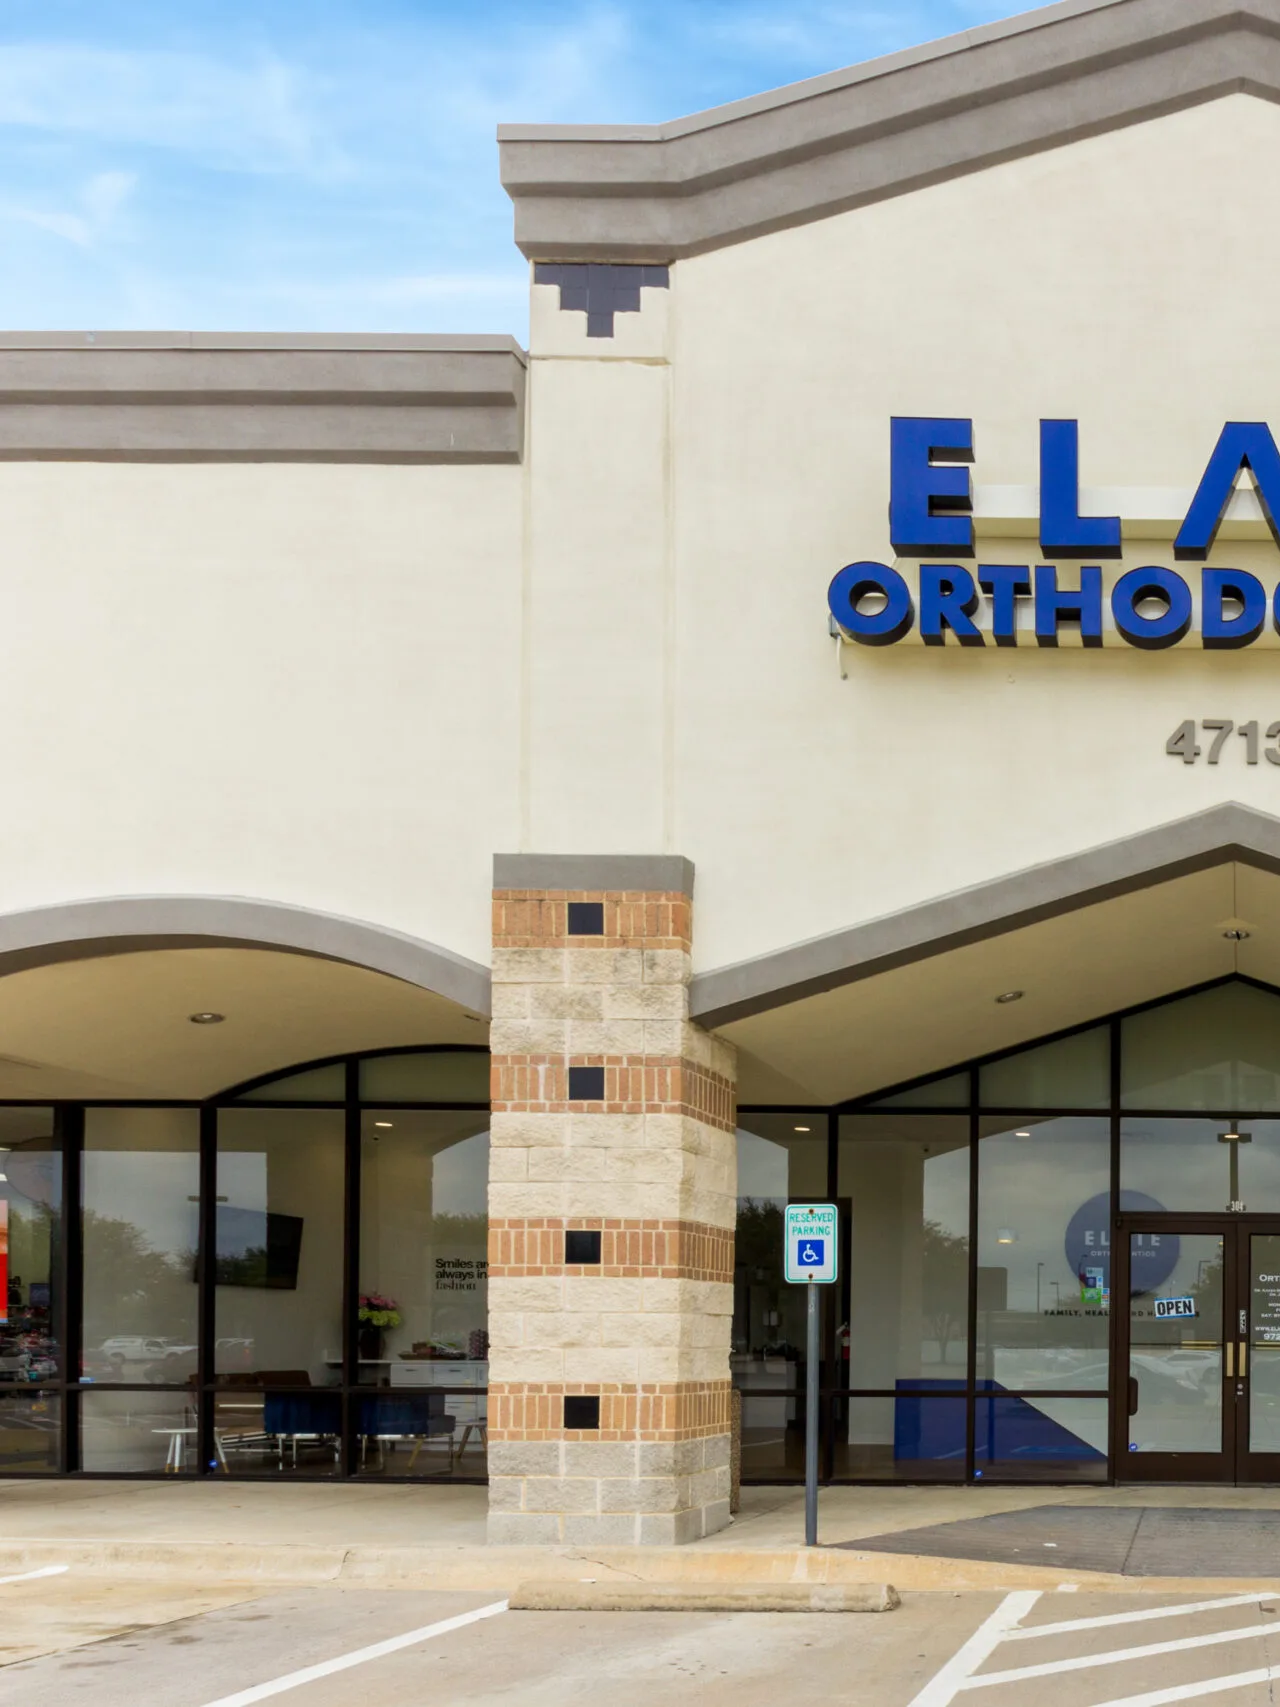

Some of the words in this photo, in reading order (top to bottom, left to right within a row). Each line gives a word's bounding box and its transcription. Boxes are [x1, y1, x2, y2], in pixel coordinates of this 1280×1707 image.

[789, 1212, 834, 1223] RESERVED
[792, 1226, 831, 1236] PARKING
[435, 1258, 474, 1269] Smiles
[435, 1269, 475, 1281] always
[477, 1270, 488, 1280] in
[436, 1280, 477, 1290] fashion
[1156, 1299, 1193, 1316] OPEN
